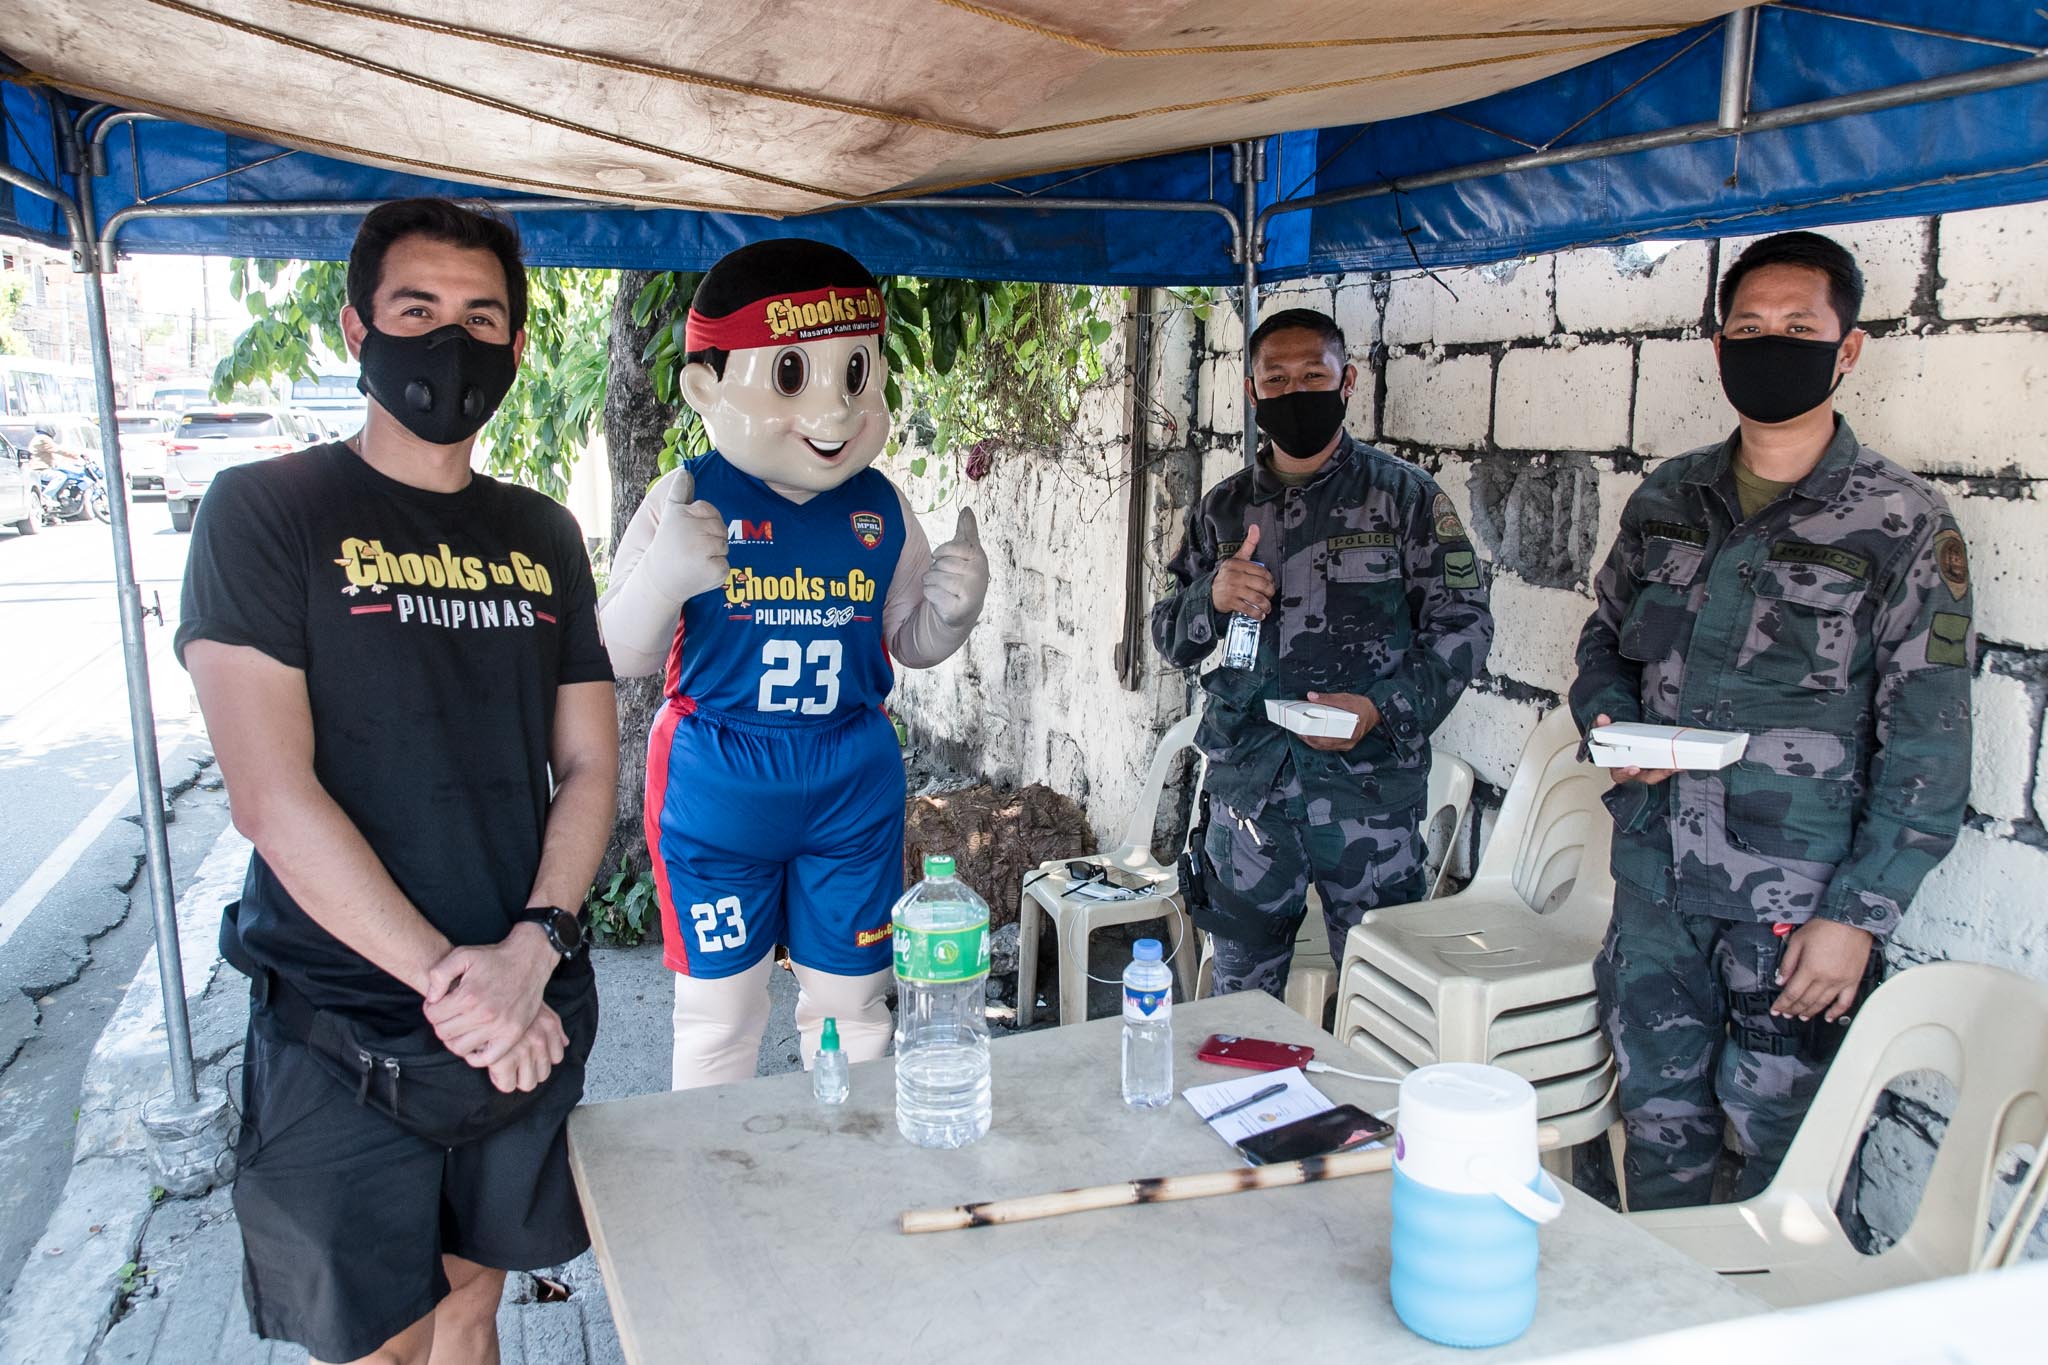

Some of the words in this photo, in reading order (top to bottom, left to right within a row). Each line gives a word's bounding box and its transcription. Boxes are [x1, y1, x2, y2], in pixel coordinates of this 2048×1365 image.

[766, 291, 857, 335] Chooks
[856, 299, 867, 315] to
[800, 328, 833, 339] Masarap
[834, 324, 851, 332] Kahit
[856, 522, 880, 531] MPBL
[1334, 534, 1391, 548] POLICE
[340, 537, 487, 591] Chooks
[489, 562, 514, 585] to
[510, 551, 553, 596] Go
[1781, 545, 1859, 571] POLICE
[725, 567, 826, 604] Chooks
[829, 580, 846, 597] to
[848, 569, 875, 603] Go
[397, 594, 534, 629] PILIPINAS
[755, 608, 822, 626] PILIPINAS
[758, 639, 843, 715] 23
[691, 895, 747, 953] 23
